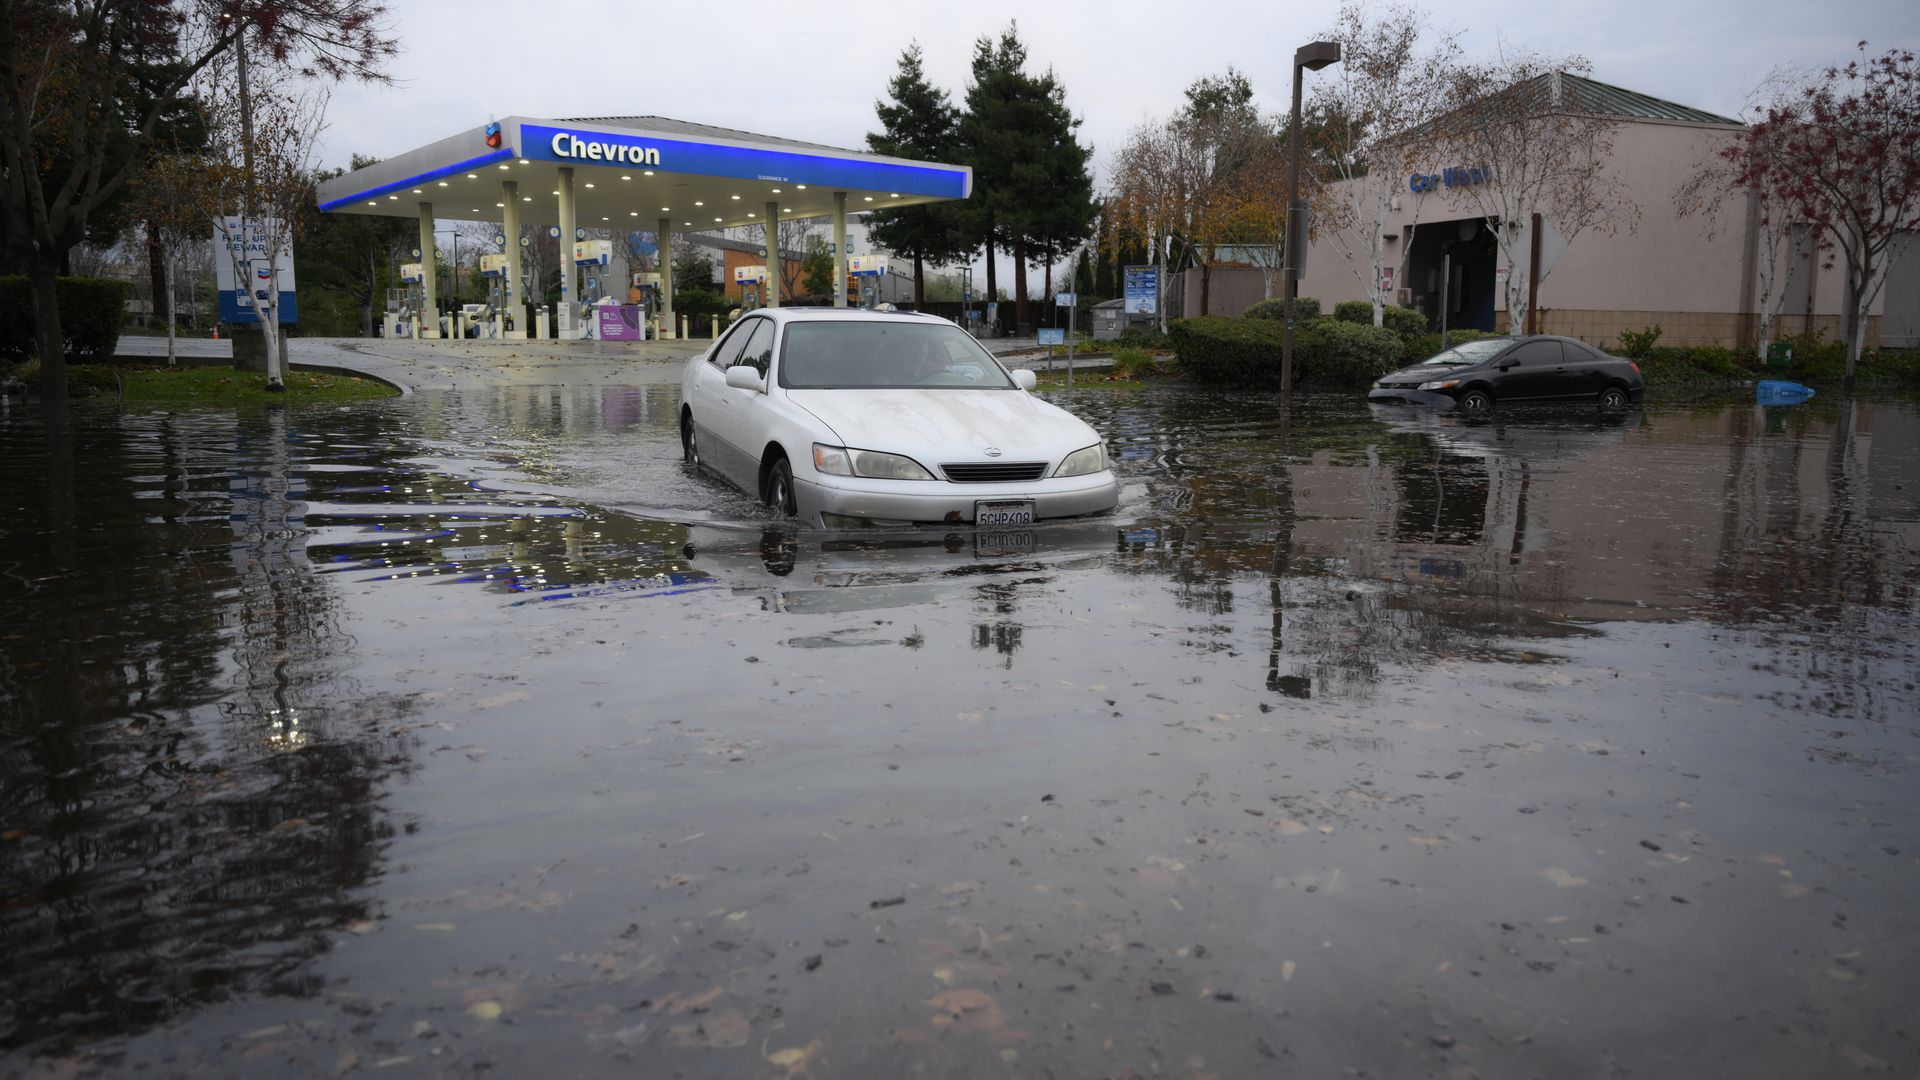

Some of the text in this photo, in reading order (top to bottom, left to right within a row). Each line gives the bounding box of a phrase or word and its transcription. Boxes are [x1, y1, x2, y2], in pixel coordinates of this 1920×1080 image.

[552, 132, 660, 165] Chevron
[1410, 173, 1441, 192] Car
[252, 234, 266, 243] UP
[980, 511, 1030, 526] 5GHP608
